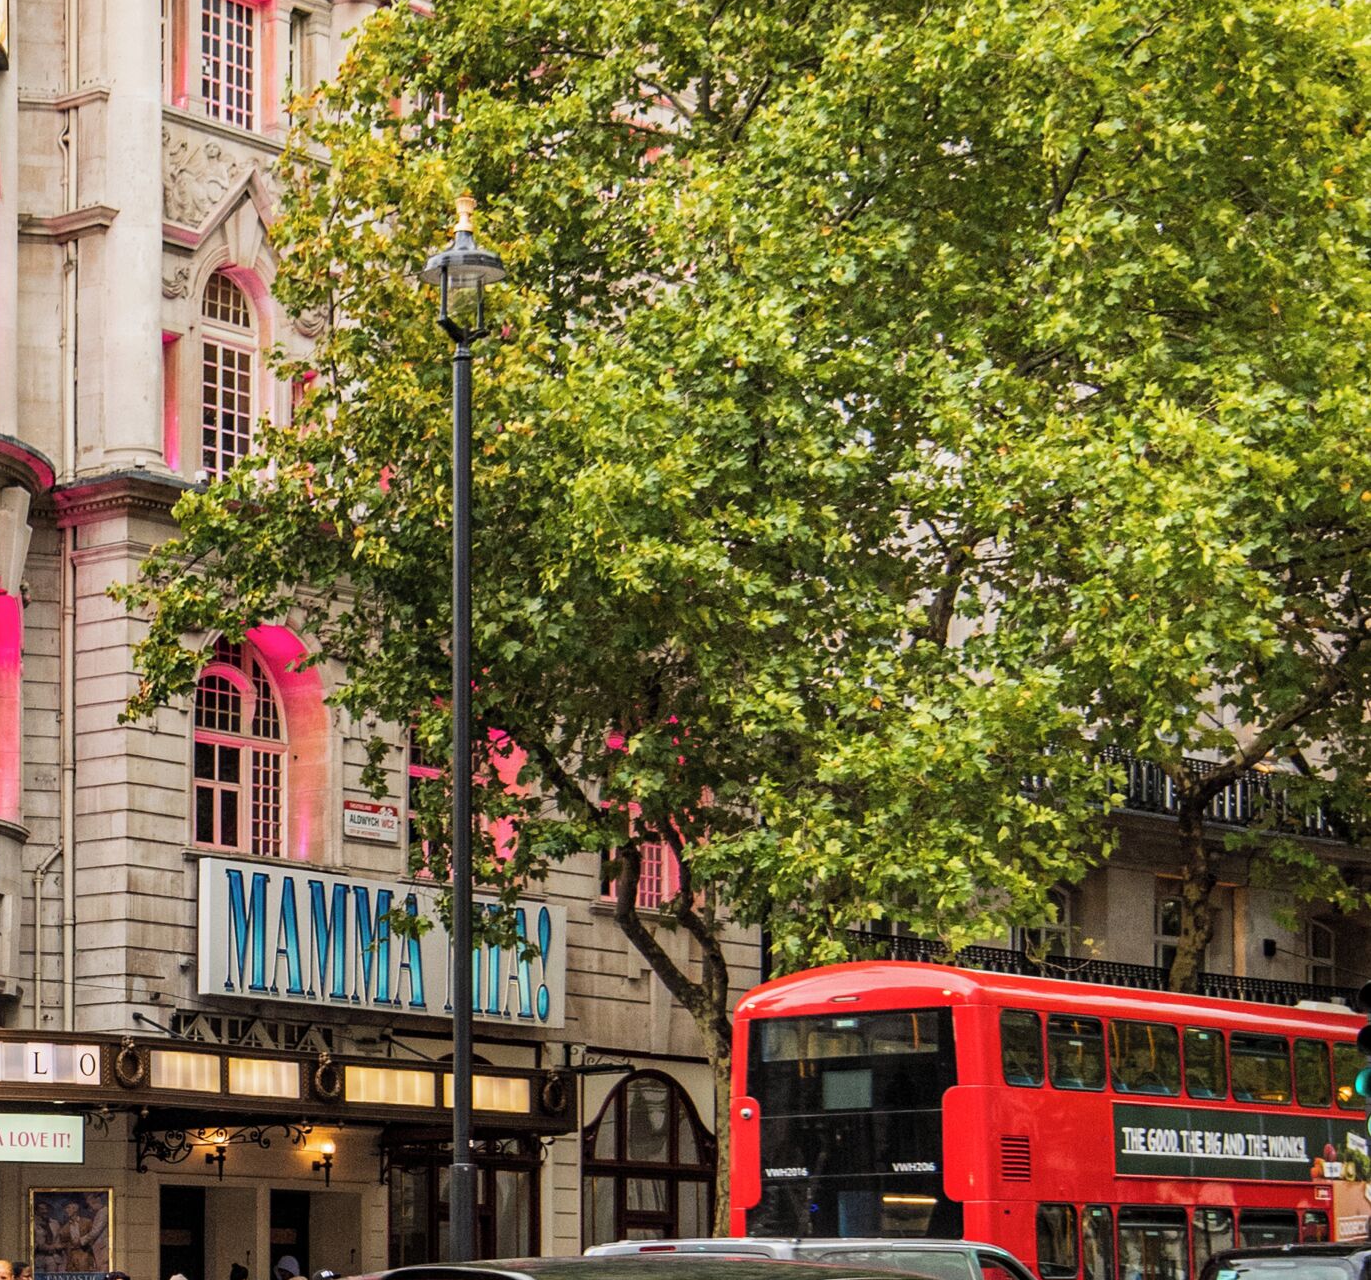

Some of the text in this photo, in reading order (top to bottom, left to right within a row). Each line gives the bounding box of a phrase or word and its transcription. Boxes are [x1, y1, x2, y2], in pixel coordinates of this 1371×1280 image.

[224, 868, 427, 1011] MAMMA
[9, 1131, 49, 1148] LOVE
[53, 1132, 71, 1148] IT!
[1121, 1127, 1146, 1152] THE
[1180, 1130, 1203, 1153] THE
[1204, 1131, 1222, 1154] BIG
[1223, 1133, 1245, 1156] AND
[1246, 1134, 1267, 1157] THE
